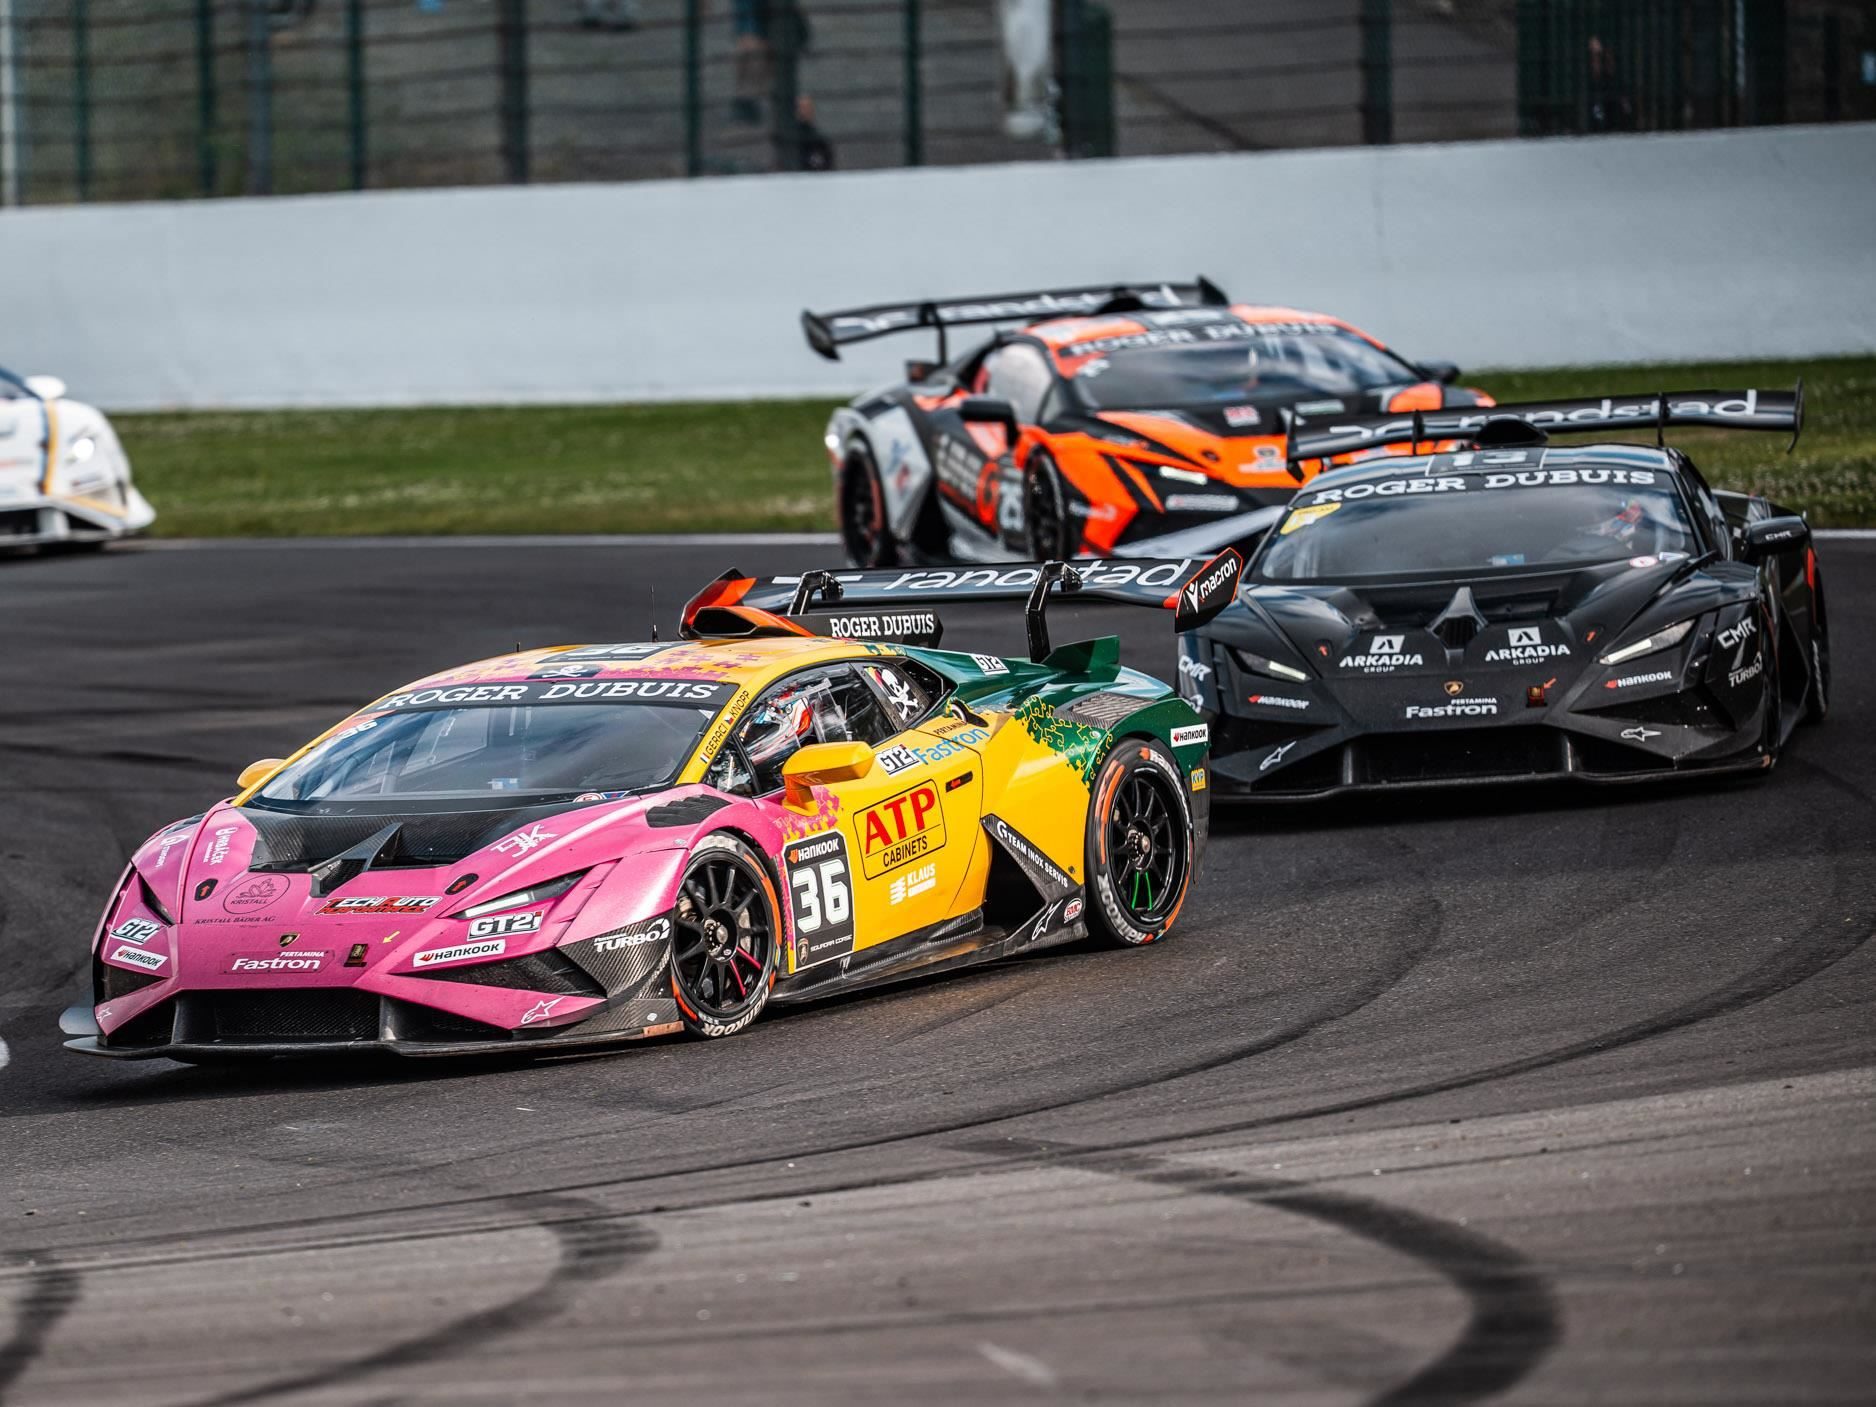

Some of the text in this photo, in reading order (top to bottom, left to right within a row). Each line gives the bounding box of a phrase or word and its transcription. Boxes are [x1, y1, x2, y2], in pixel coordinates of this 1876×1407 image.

[1459, 389, 1757, 428] rndstad
[1312, 469, 1655, 505] ROGER DUBUIS
[1200, 557, 1237, 599] macron
[830, 613, 935, 637] ROGER DUBUIS
[1717, 616, 1757, 649] CMR
[1339, 653, 1423, 668] ARKADIA
[1484, 643, 1571, 662] ARKADIA
[1512, 657, 1545, 666] GROUP
[1729, 662, 1760, 688] TURBO
[377, 682, 719, 710] ROGER DUBUIS
[1451, 697, 1497, 705] PERTAMINA
[705, 690, 750, 755] GERACI KNOPP
[1405, 703, 1498, 719] Fastron
[911, 728, 990, 765] Fastron
[866, 788, 935, 855] ATP
[883, 835, 928, 867] CABINETS
[1008, 832, 1027, 856] TEAM
[1027, 849, 1044, 869] INOX
[1044, 862, 1068, 888] SERVIS
[907, 863, 936, 887] KLAUS
[792, 858, 849, 934] 36
[594, 930, 661, 952] TURBO
[231, 957, 321, 971] Fastron
